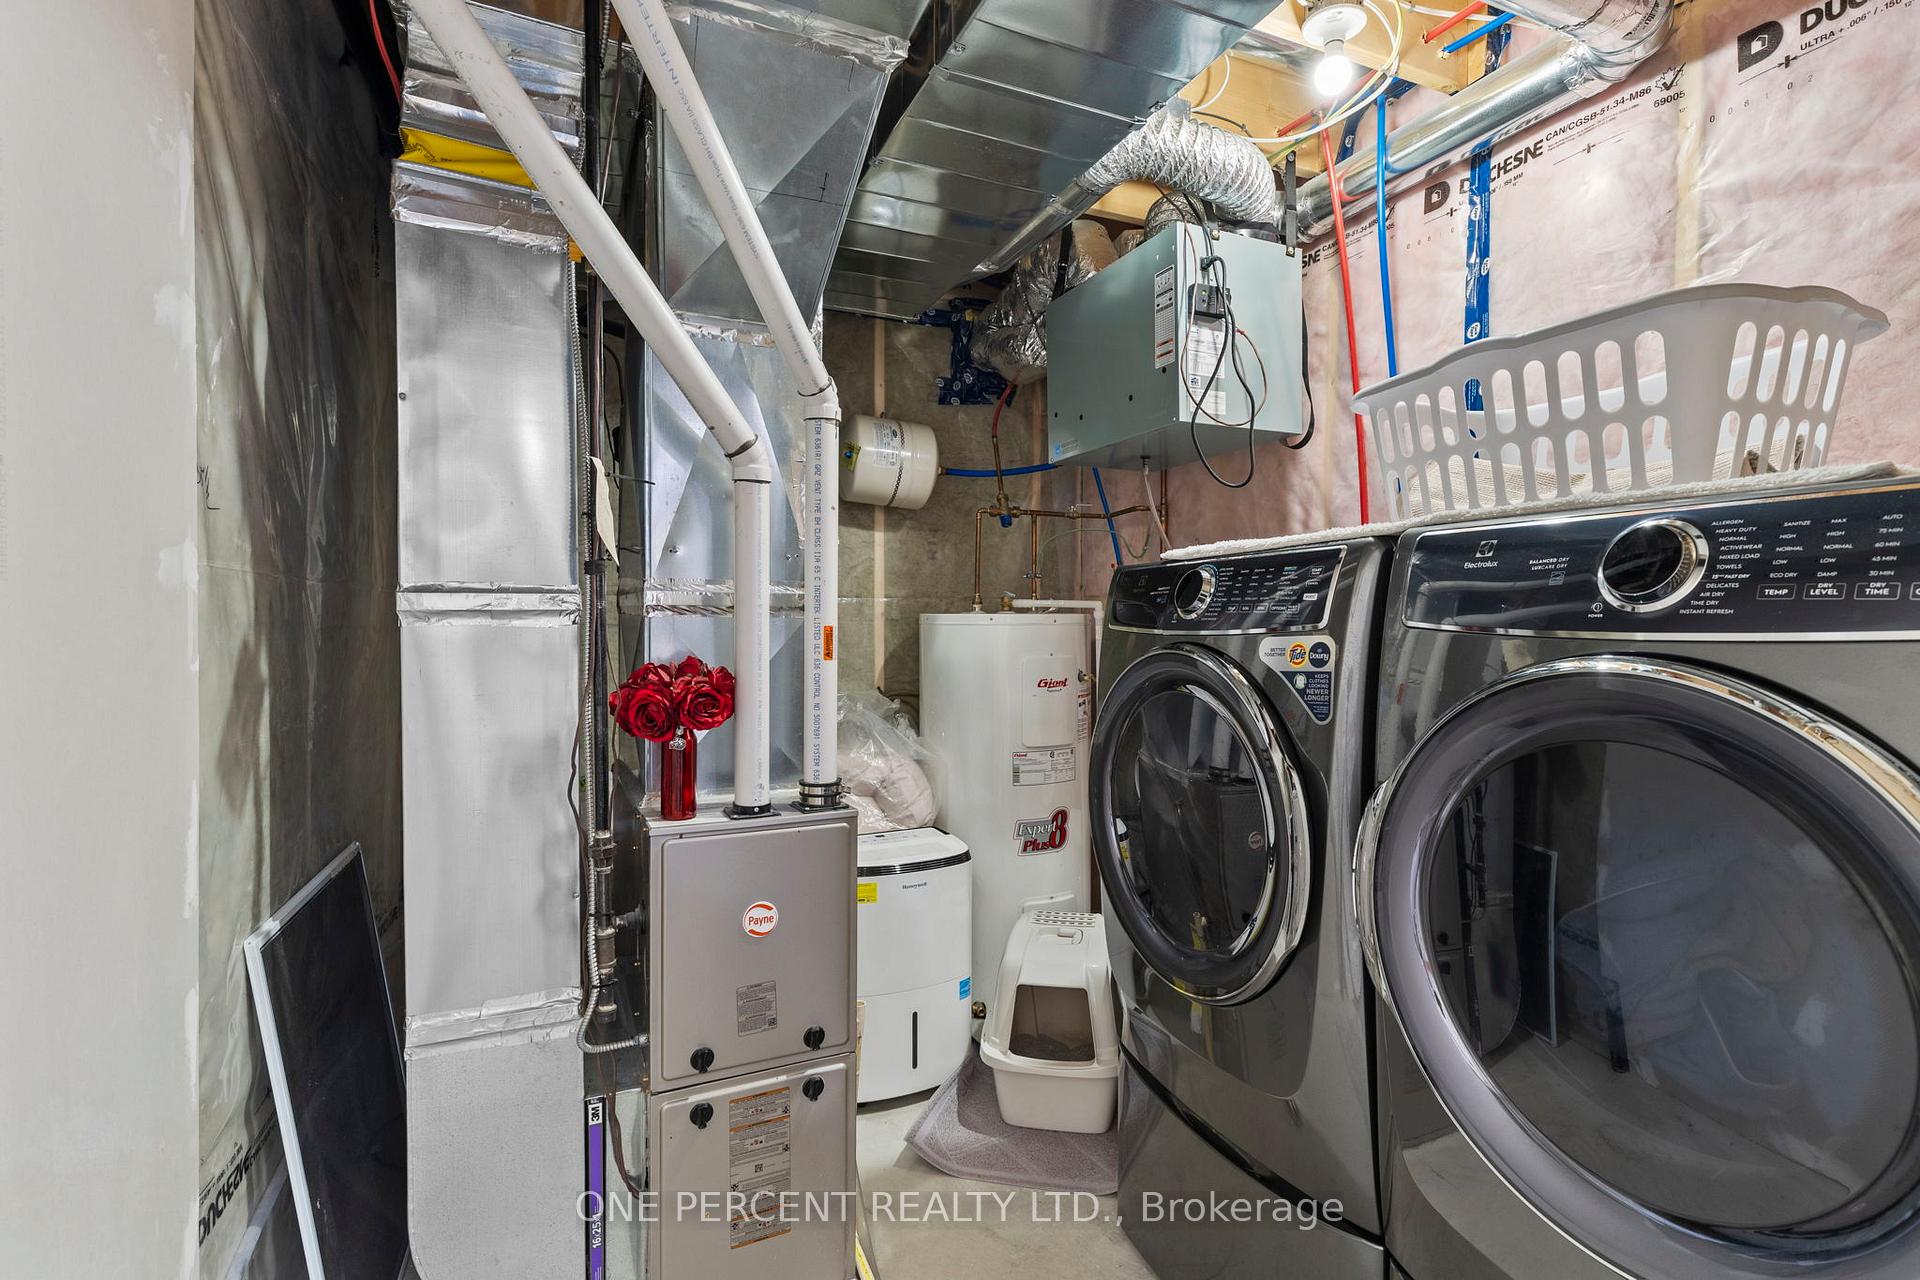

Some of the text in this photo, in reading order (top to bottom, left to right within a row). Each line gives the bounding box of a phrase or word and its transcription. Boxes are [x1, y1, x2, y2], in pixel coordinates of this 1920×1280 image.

[1800, 29, 1835, 51] ULTRA
[1653, 90, 1686, 108] 69005
[814, 479, 822, 495] VENT
[814, 498, 822, 514] TYPE
[1783, 519, 1812, 527] SANITIZE
[814, 528, 822, 548] CLASS
[1720, 543, 1762, 551] ACTIVEWEAR
[1463, 561, 1499, 570] Electrolux
[1529, 557, 1558, 565] BALANCED
[1809, 588, 1839, 596] LEVEL
[1864, 588, 1890, 596] TIME
[813, 616, 821, 641] LISTED
[1289, 647, 1307, 664] Tide
[1309, 652, 1330, 661] Downy
[813, 673, 821, 699] CONTROL
[1037, 677, 1068, 689] Giant
[813, 743, 821, 767] SYSTEM
[1018, 821, 1057, 838] Expert
[1022, 838, 1052, 852] Plus
[748, 914, 775, 928] Payne
[591, 1106, 601, 1122] 3M
